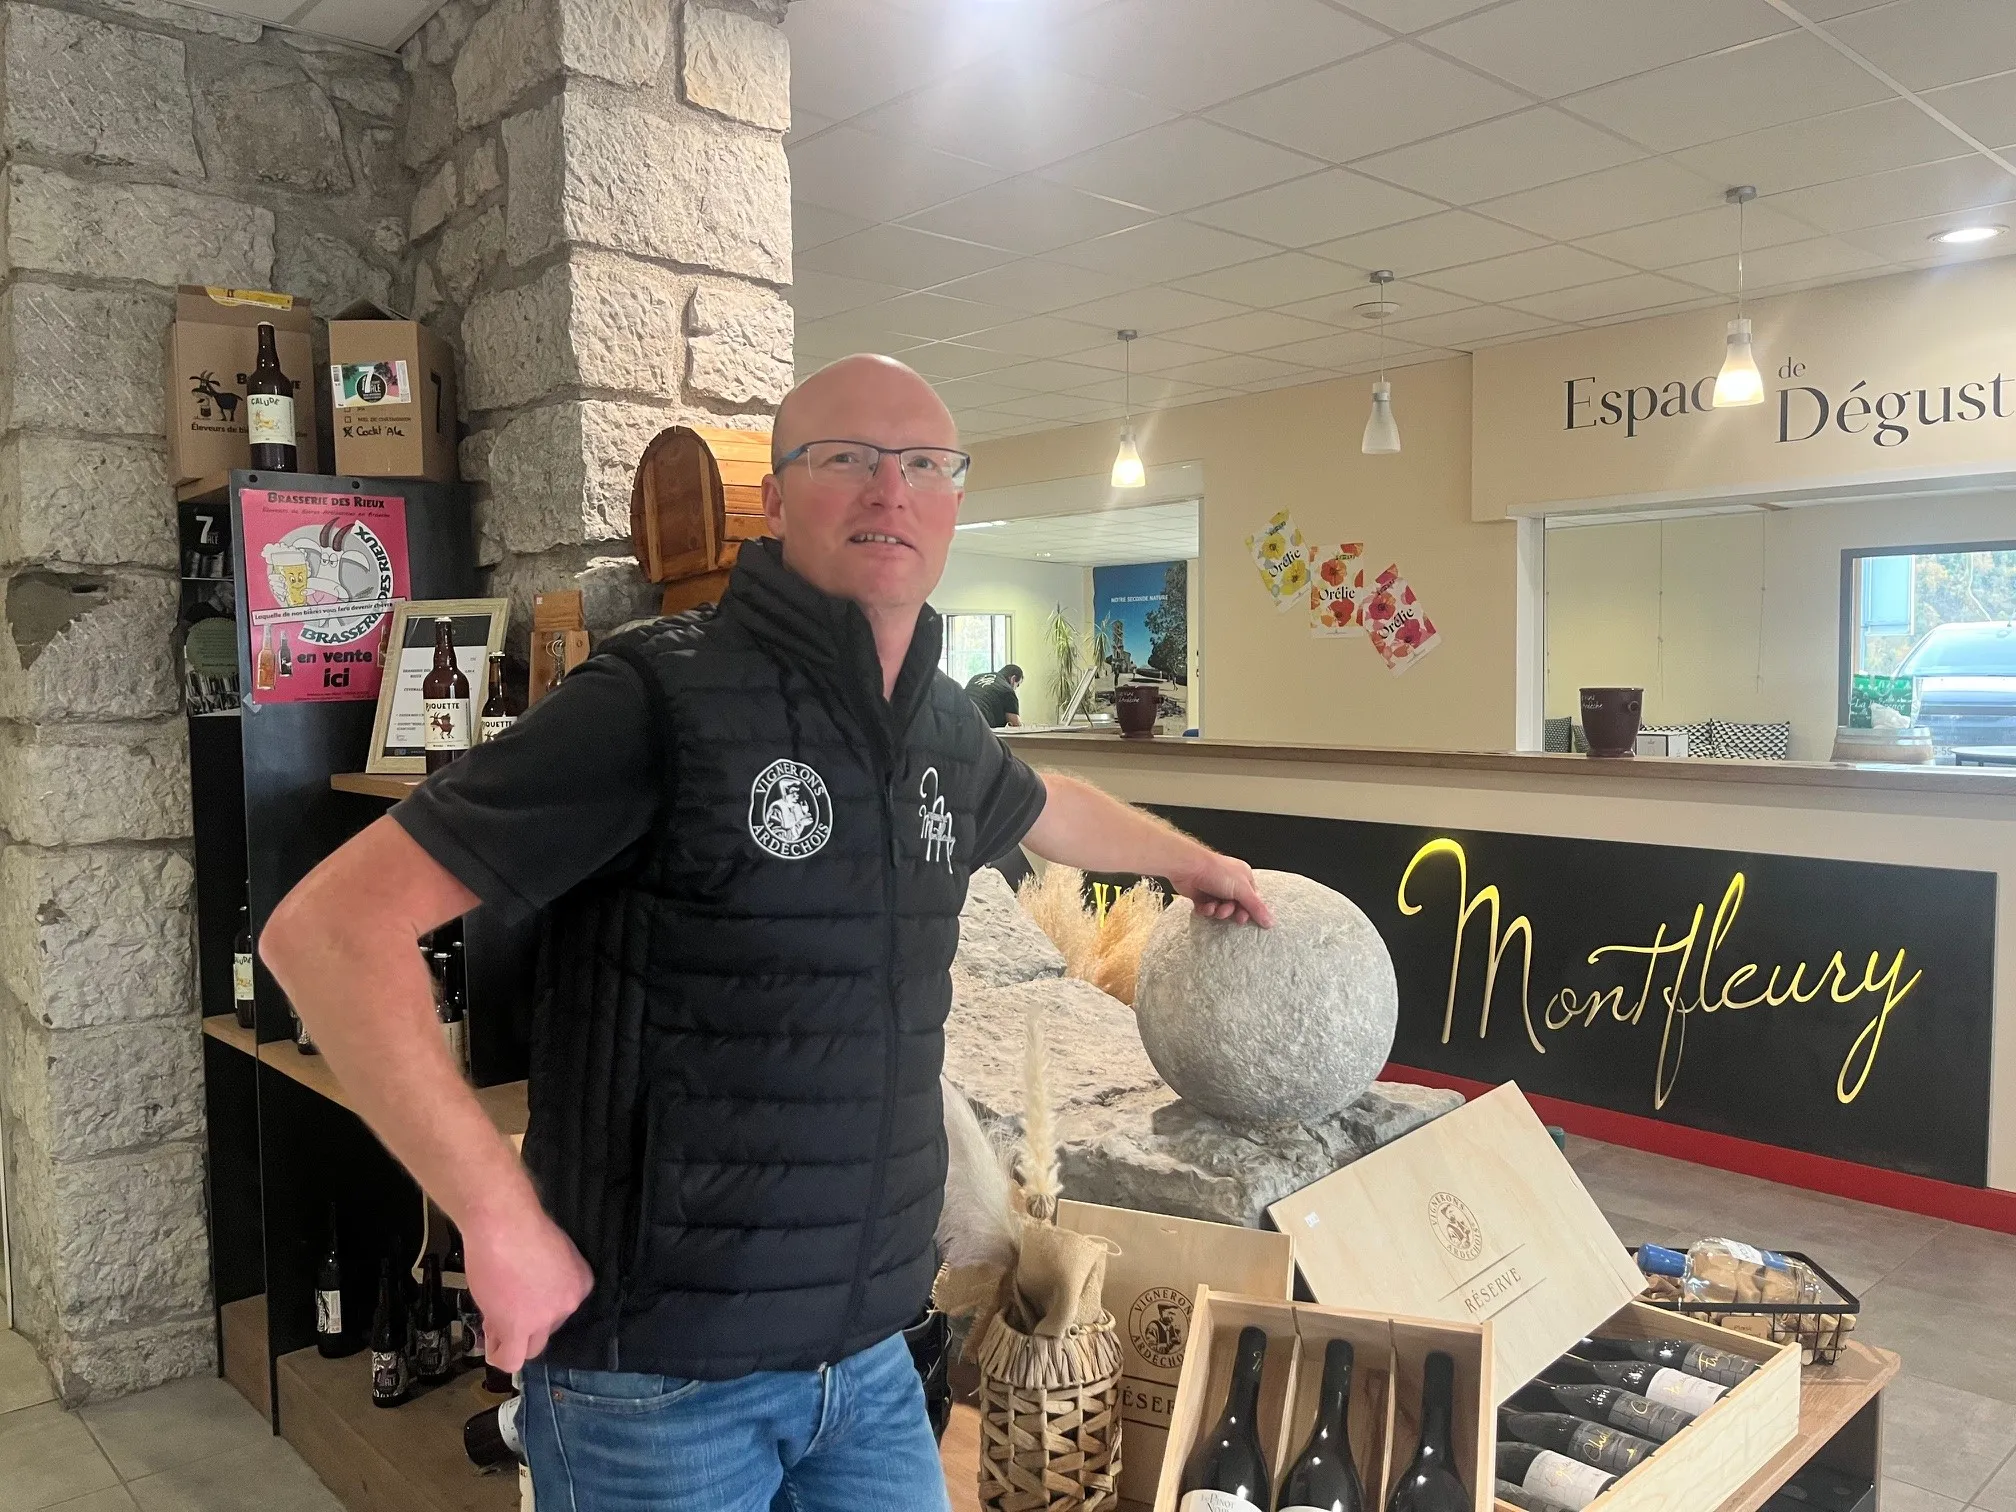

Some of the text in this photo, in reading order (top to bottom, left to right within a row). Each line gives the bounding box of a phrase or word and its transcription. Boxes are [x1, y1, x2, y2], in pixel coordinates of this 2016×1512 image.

[1778, 357, 1806, 380] de
[250, 396, 280, 407] CALUDE
[1563, 376, 1717, 438] Espac
[1775, 372, 2016, 447] Dégust
[267, 492, 385, 509] BRASSERIE DES RIEUX
[196, 515, 214, 544] 7
[300, 612, 382, 644] BRASSERI
[354, 526, 391, 573] RIEUX
[1149, 594, 1168, 602] NATURE
[351, 603, 373, 611] devenir
[297, 649, 373, 664] en vente
[323, 667, 350, 688] ici
[755, 762, 824, 796] VIGNERONS
[752, 823, 829, 856] ARDECHOIS
[1398, 837, 1923, 1110] Montfleury
[1429, 1194, 1465, 1226] VIGNERONS
[1447, 1226, 1482, 1259] ARDECHOIS
[1134, 1288, 1195, 1313] VIGNERON
[1464, 1267, 1522, 1314] RÉSERVE
[1132, 1334, 1184, 1369] ARDECHO
[1209, 1493, 1234, 1509] PINOT
